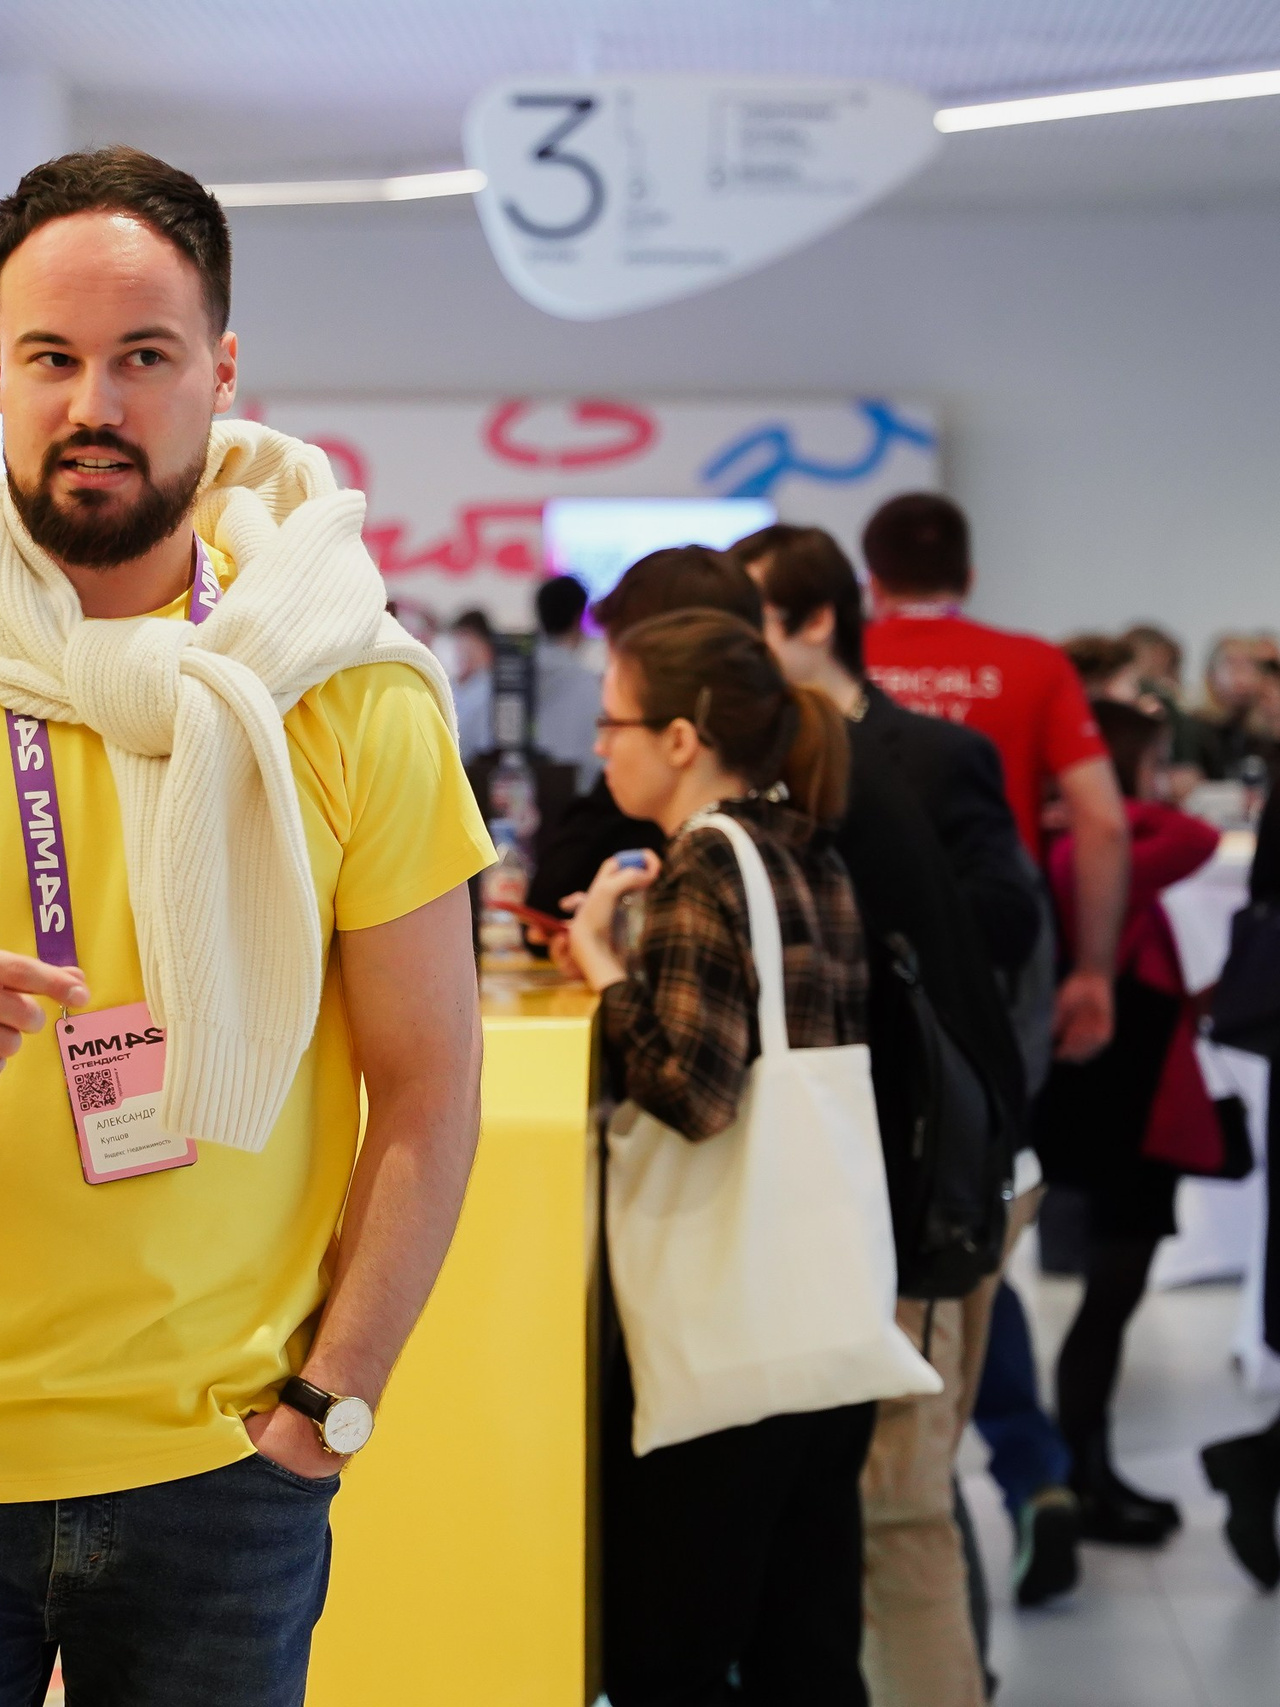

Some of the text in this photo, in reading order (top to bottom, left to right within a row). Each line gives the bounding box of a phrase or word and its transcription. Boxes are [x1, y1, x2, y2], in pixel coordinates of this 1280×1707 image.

[505, 95, 605, 241] 3
[71, 1052, 131, 1071] СТЕНДИСТ
[96, 1107, 157, 1131] АЛЕКСАНДР
[100, 1131, 130, 1145] Купцов
[104, 1138, 172, 1160] Яндекс Недвижимость
